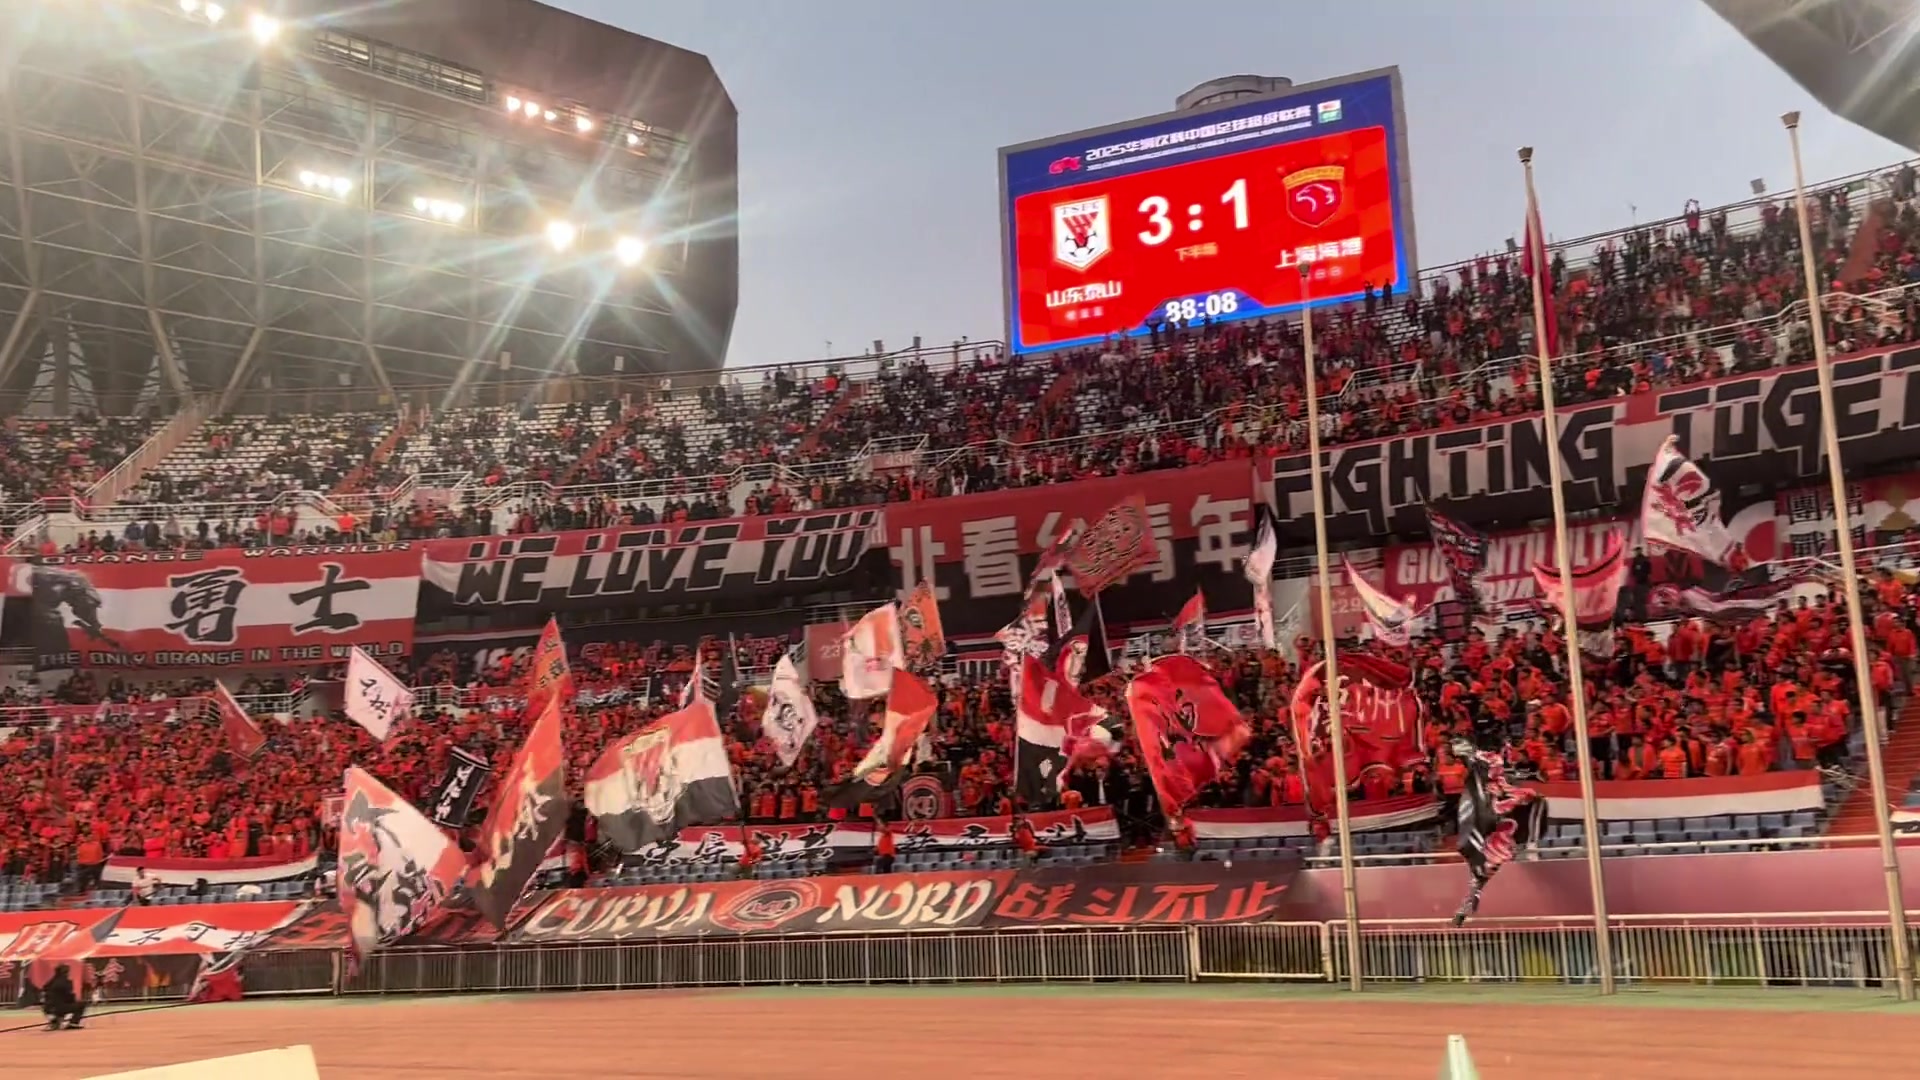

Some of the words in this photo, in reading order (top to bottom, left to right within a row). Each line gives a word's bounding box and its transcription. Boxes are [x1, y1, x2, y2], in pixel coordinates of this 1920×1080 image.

[1137, 195, 1174, 246] 3
[1221, 178, 1250, 230] 1
[1046, 279, 1122, 308] 山东泰山
[1272, 405, 1616, 536] FIGHTING
[42, 551, 205, 565] ORANGE
[243, 541, 412, 557] WARRIOR
[454, 536, 559, 606] WE
[567, 521, 745, 598] LOVE
[755, 510, 876, 584] YOU
[164, 562, 373, 646] 勇士
[39, 652, 81, 667] THE
[90, 650, 146, 666] ONLY
[155, 648, 244, 666] ORANGE
[251, 648, 271, 661] IN
[281, 645, 322, 660] THE
[525, 886, 716, 936] CURVA
[816, 879, 993, 926] NORD
[993, 880, 1289, 923] 战斗不止
